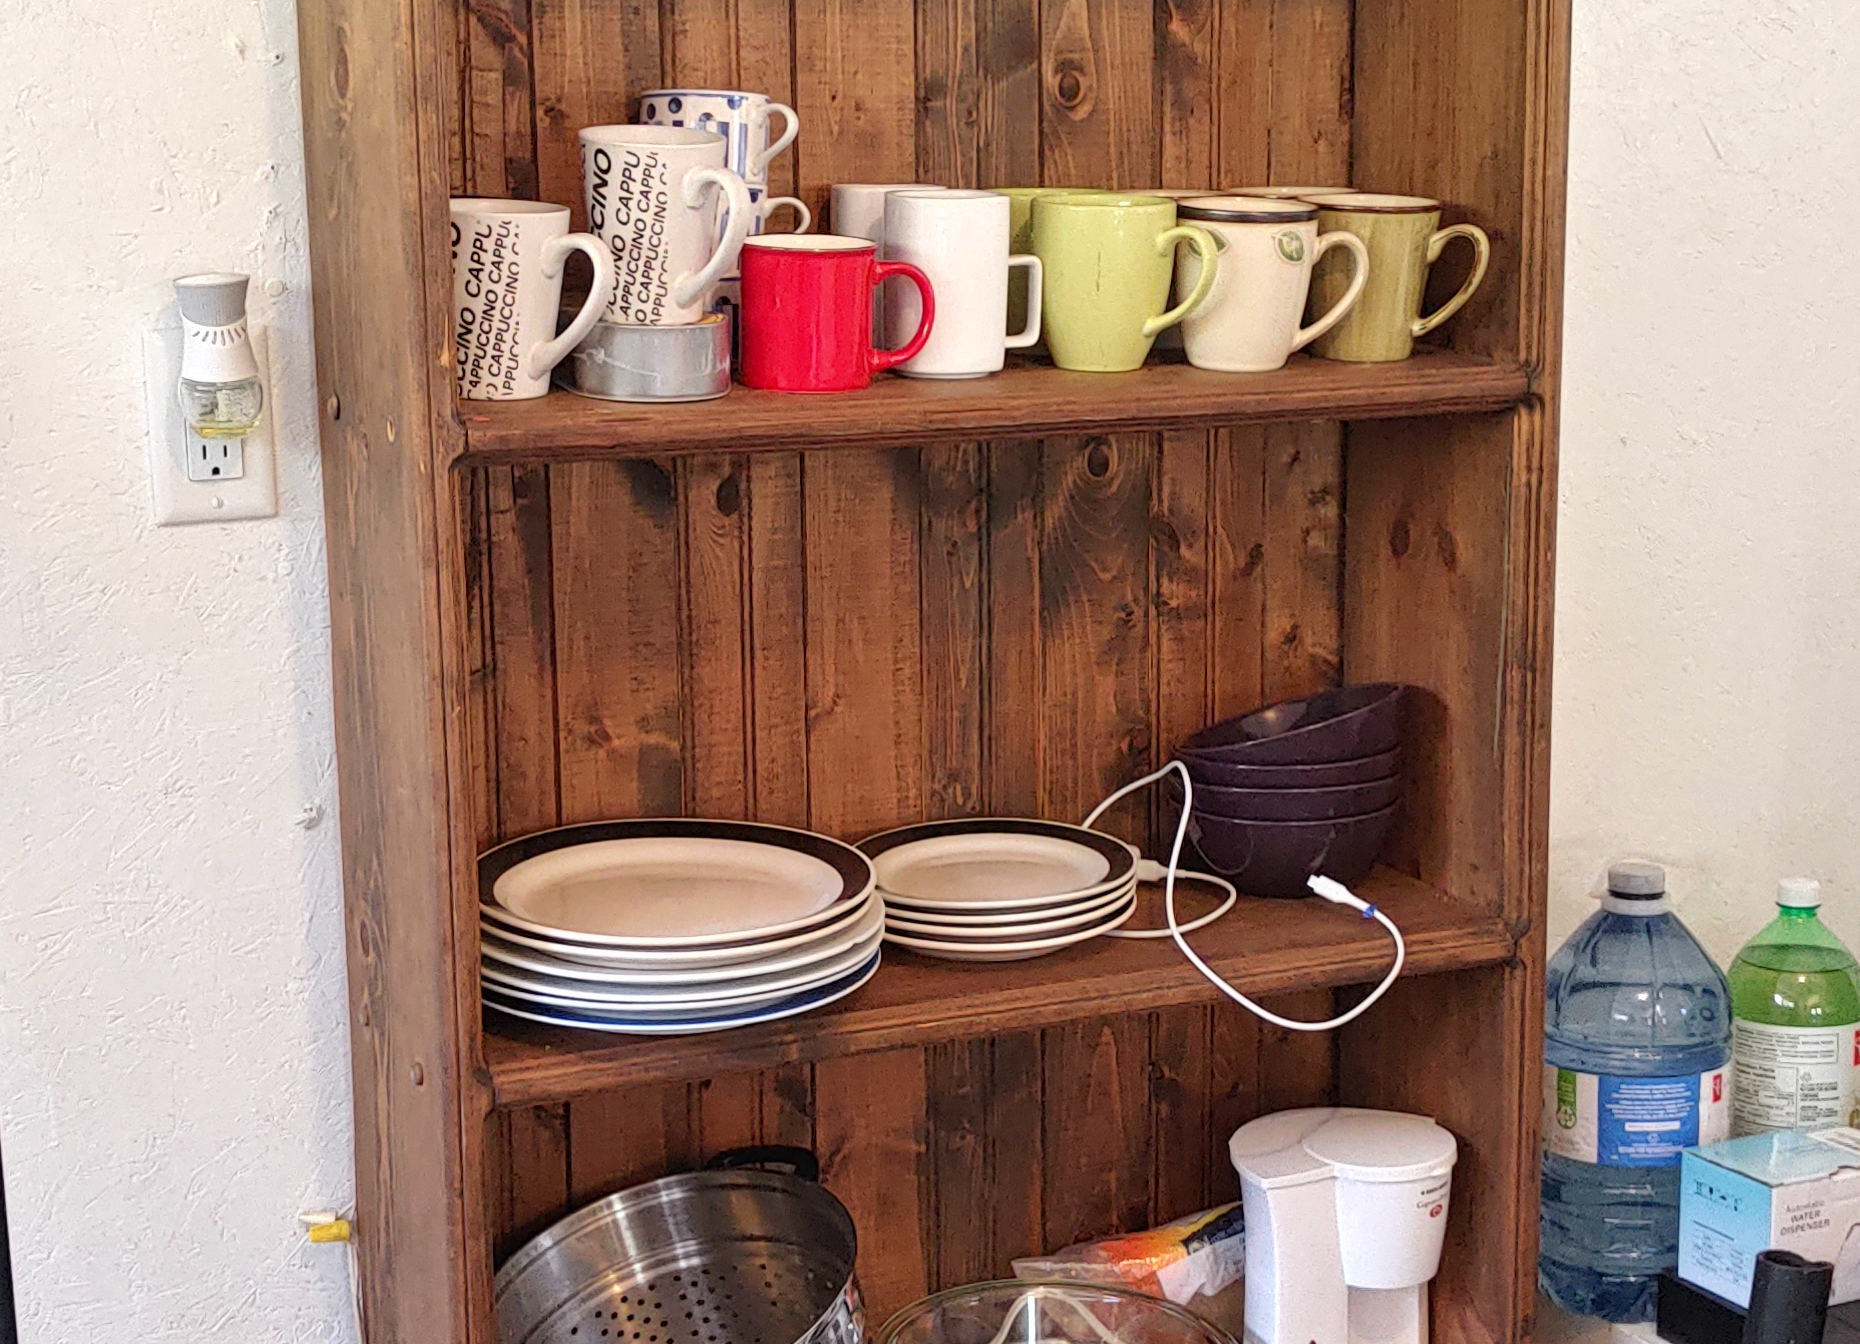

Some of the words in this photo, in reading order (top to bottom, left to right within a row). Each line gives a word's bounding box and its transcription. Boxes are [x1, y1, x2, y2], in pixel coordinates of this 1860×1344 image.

[487, 220, 513, 285] CAPPU
[618, 218, 647, 322] APPUCCINO
[636, 151, 659, 214] CAPPU
[1779, 1218, 1830, 1236] DISPENSER
[1790, 1209, 1821, 1224] WATER
